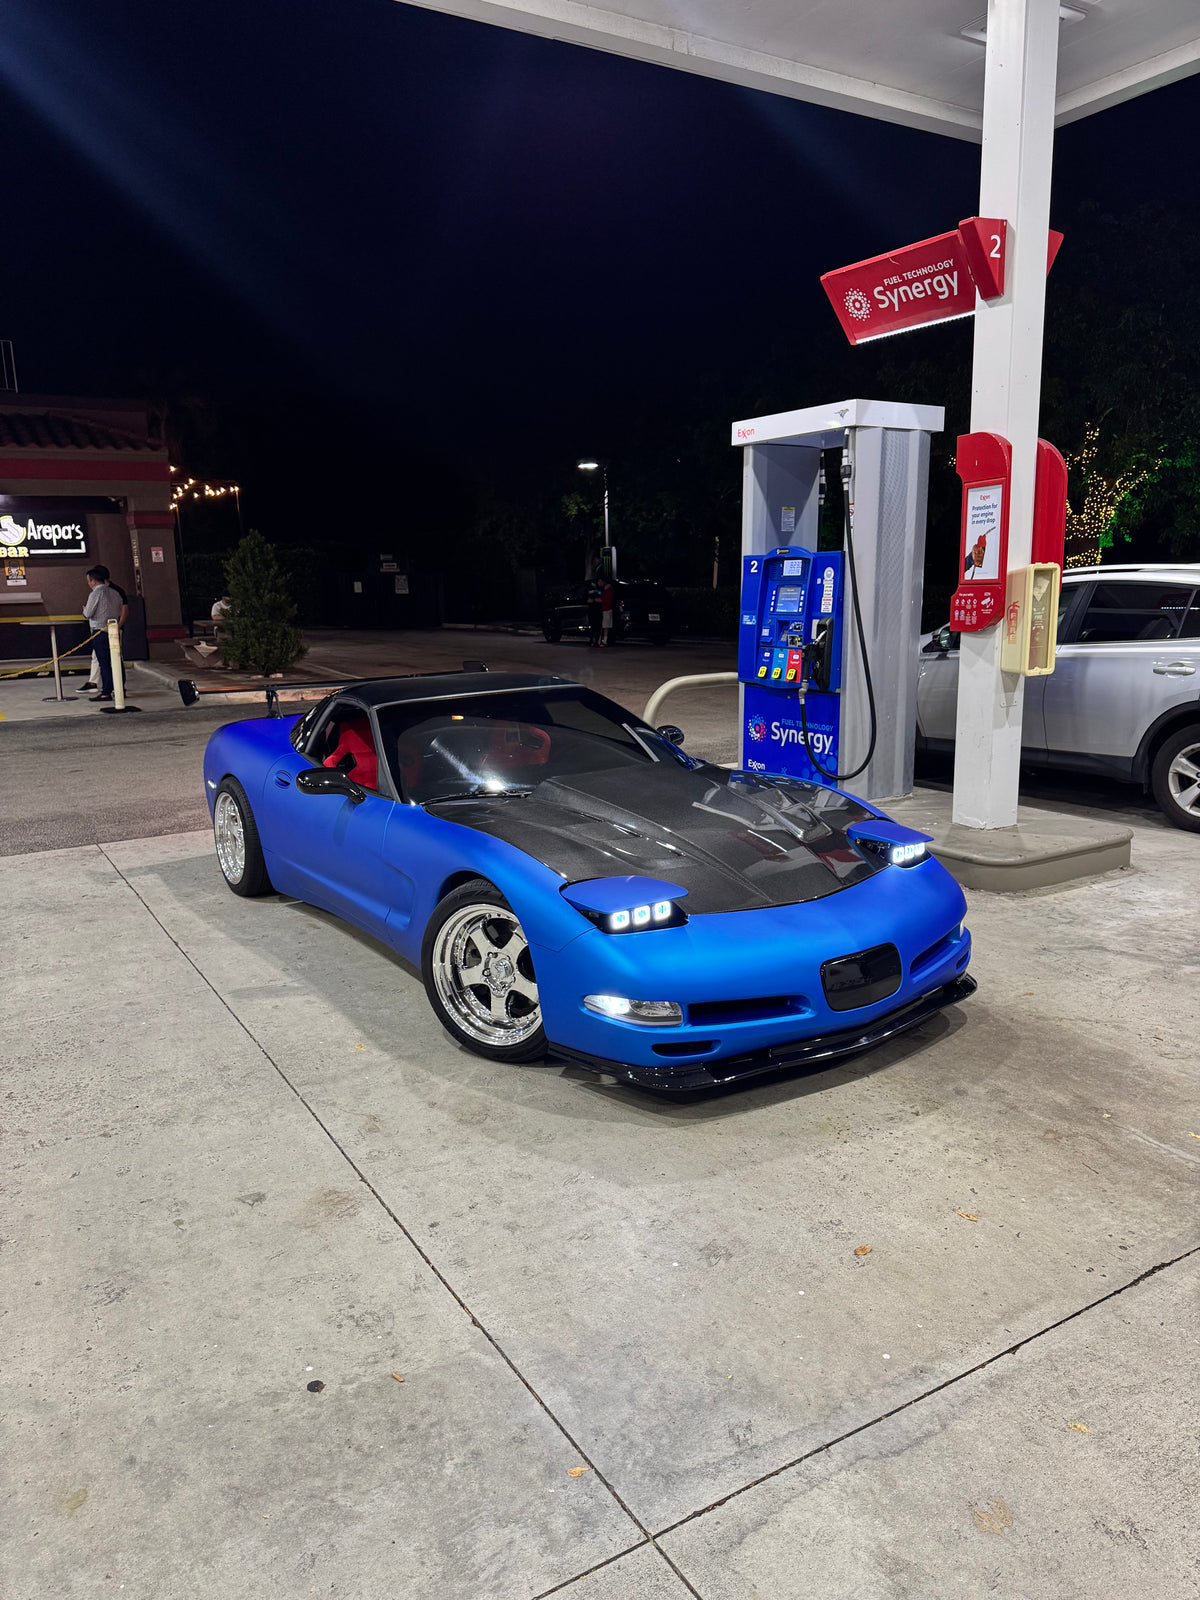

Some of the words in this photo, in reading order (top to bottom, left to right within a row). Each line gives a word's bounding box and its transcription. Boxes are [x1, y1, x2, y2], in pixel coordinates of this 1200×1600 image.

[990, 235, 1001, 258] 2
[884, 275, 903, 286] FUEL
[902, 258, 954, 280] TECHNOLOGY
[873, 270, 958, 312] Synergy
[737, 428, 755, 439] Exxon
[27, 518, 84, 546] Arepa's
[750, 560, 758, 573] 2
[781, 718, 794, 726] FUEL
[796, 720, 833, 731] TEHNOLOGY
[771, 721, 833, 754] Synergy
[748, 759, 766, 771] Exxon
